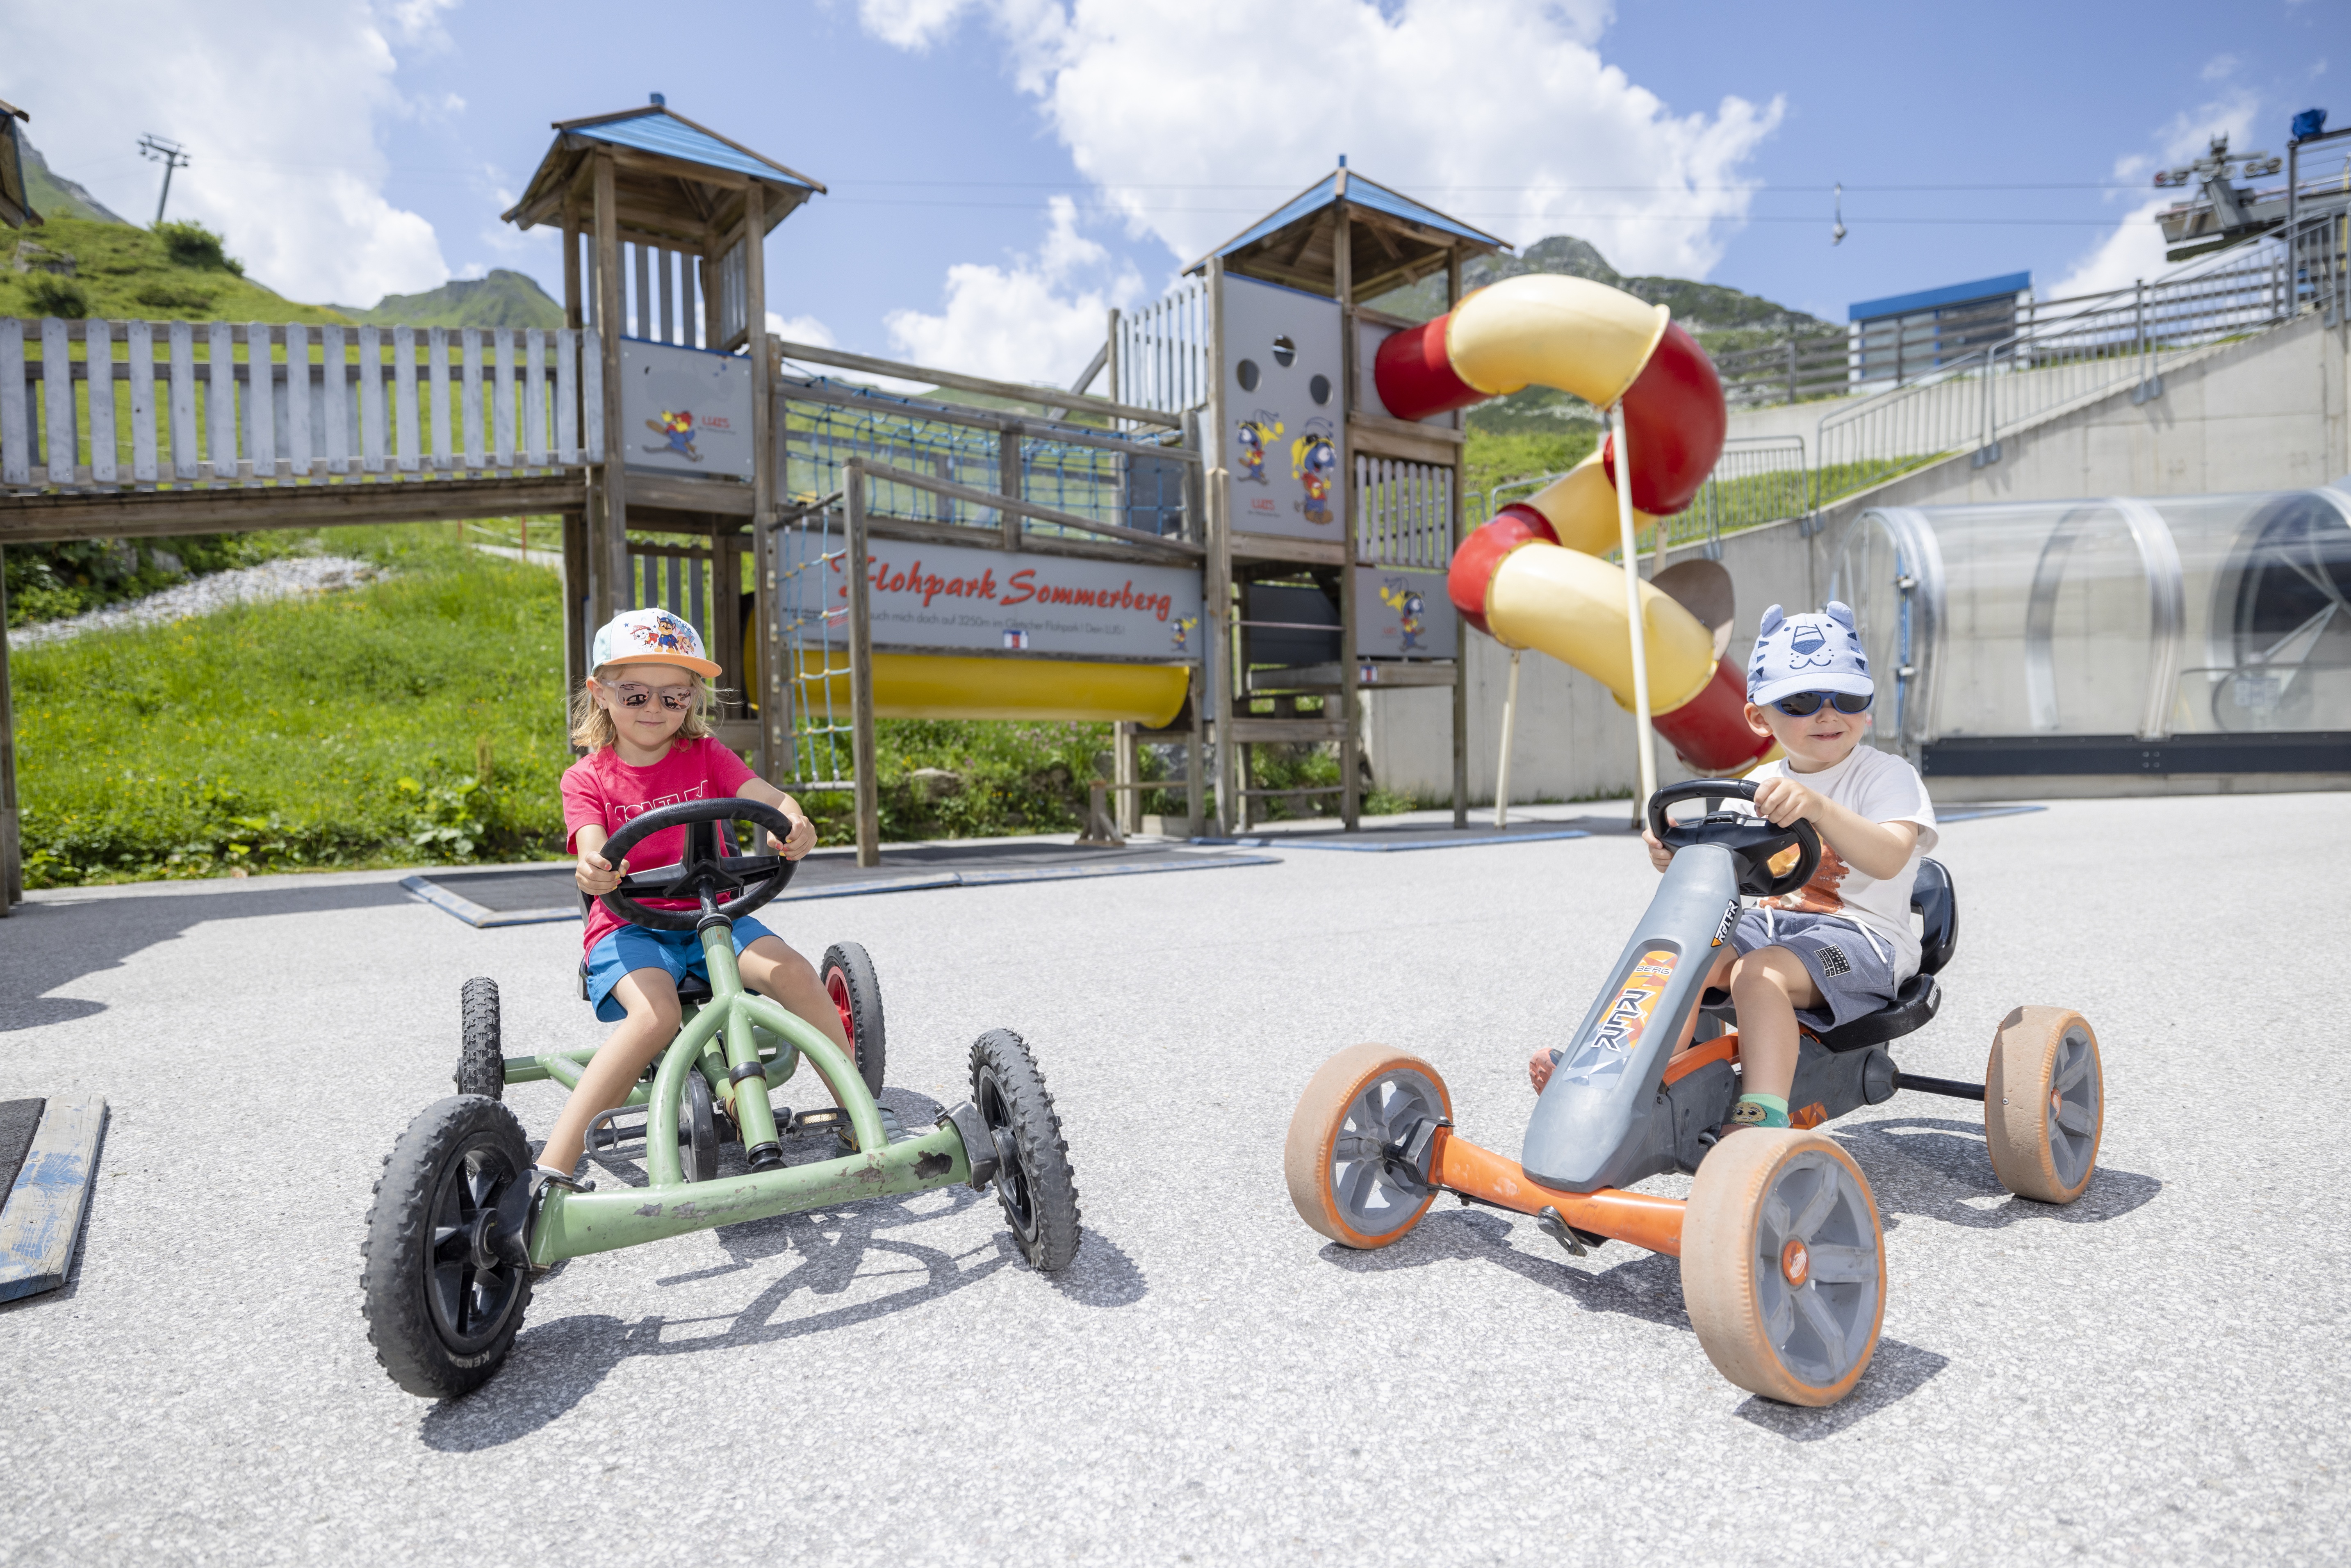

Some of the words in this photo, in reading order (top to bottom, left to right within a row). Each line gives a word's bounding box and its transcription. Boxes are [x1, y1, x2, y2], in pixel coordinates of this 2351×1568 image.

[1000, 569, 1171, 621] Sommerberg
[892, 611, 914, 622] mich
[917, 612, 939, 624] doch
[941, 614, 957, 625] auf
[958, 615, 991, 627] 3250m
[1636, 966, 1671, 974] BERG
